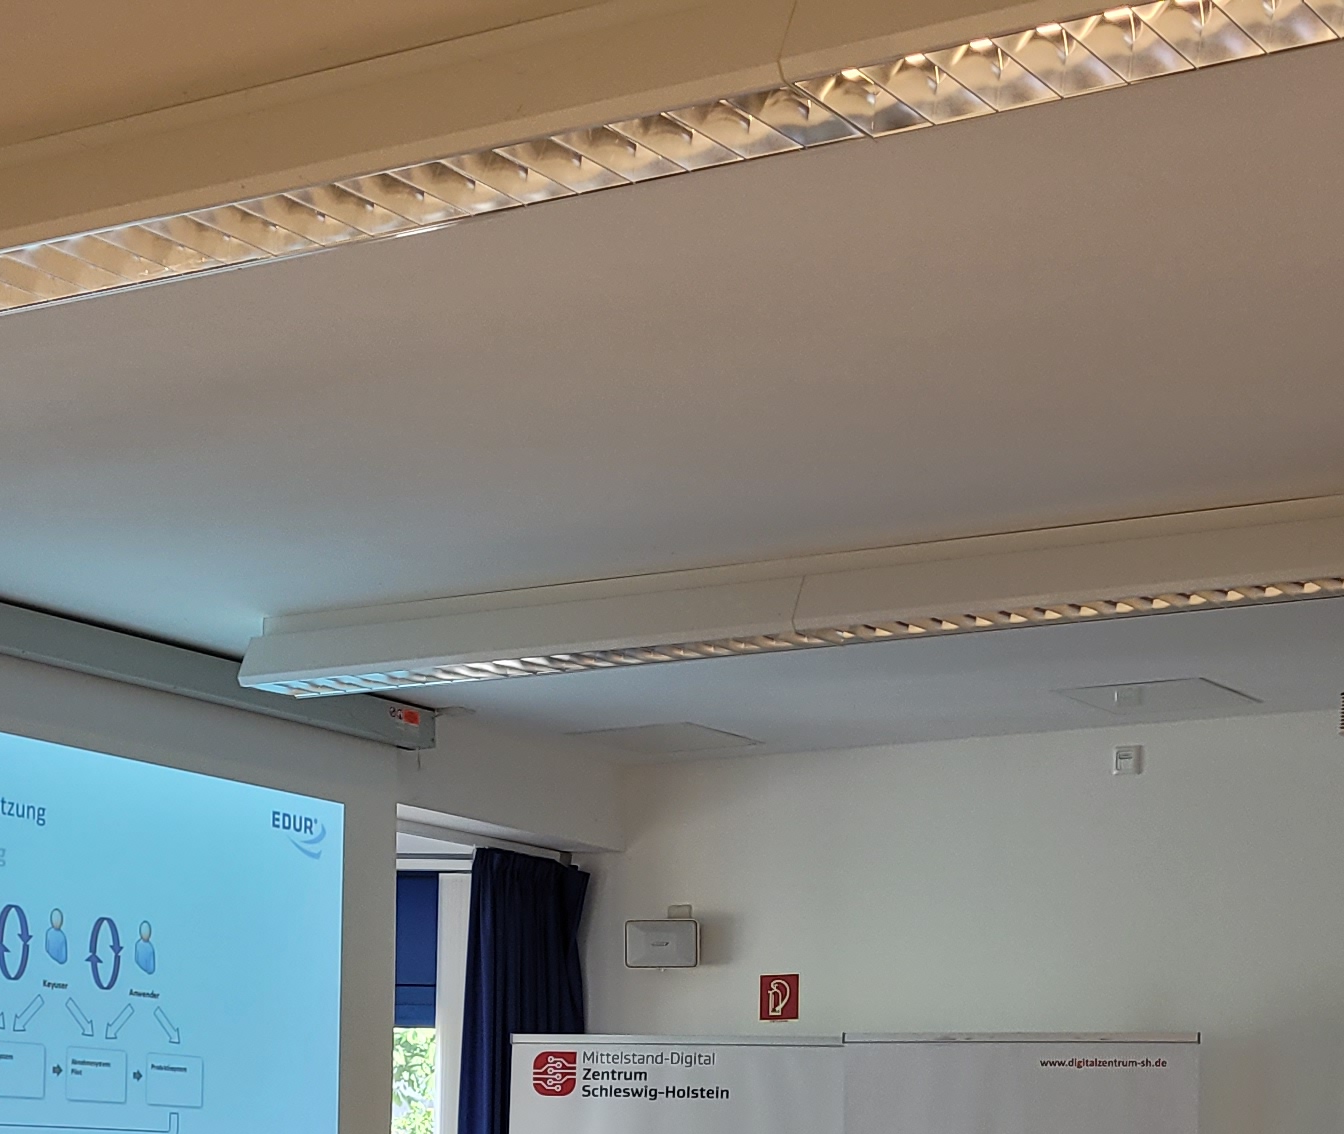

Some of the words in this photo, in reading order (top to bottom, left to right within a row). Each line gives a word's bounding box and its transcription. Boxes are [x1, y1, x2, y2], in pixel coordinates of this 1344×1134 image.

[129, 989, 160, 999] Anwender
[583, 1051, 715, 1067] Mittelstand-Digital
[1040, 1058, 1167, 1068] www.digitalzentrum-sh.de
[583, 1068, 647, 1081] Zentrum
[582, 1085, 729, 1101] Schleswig-Holstein
